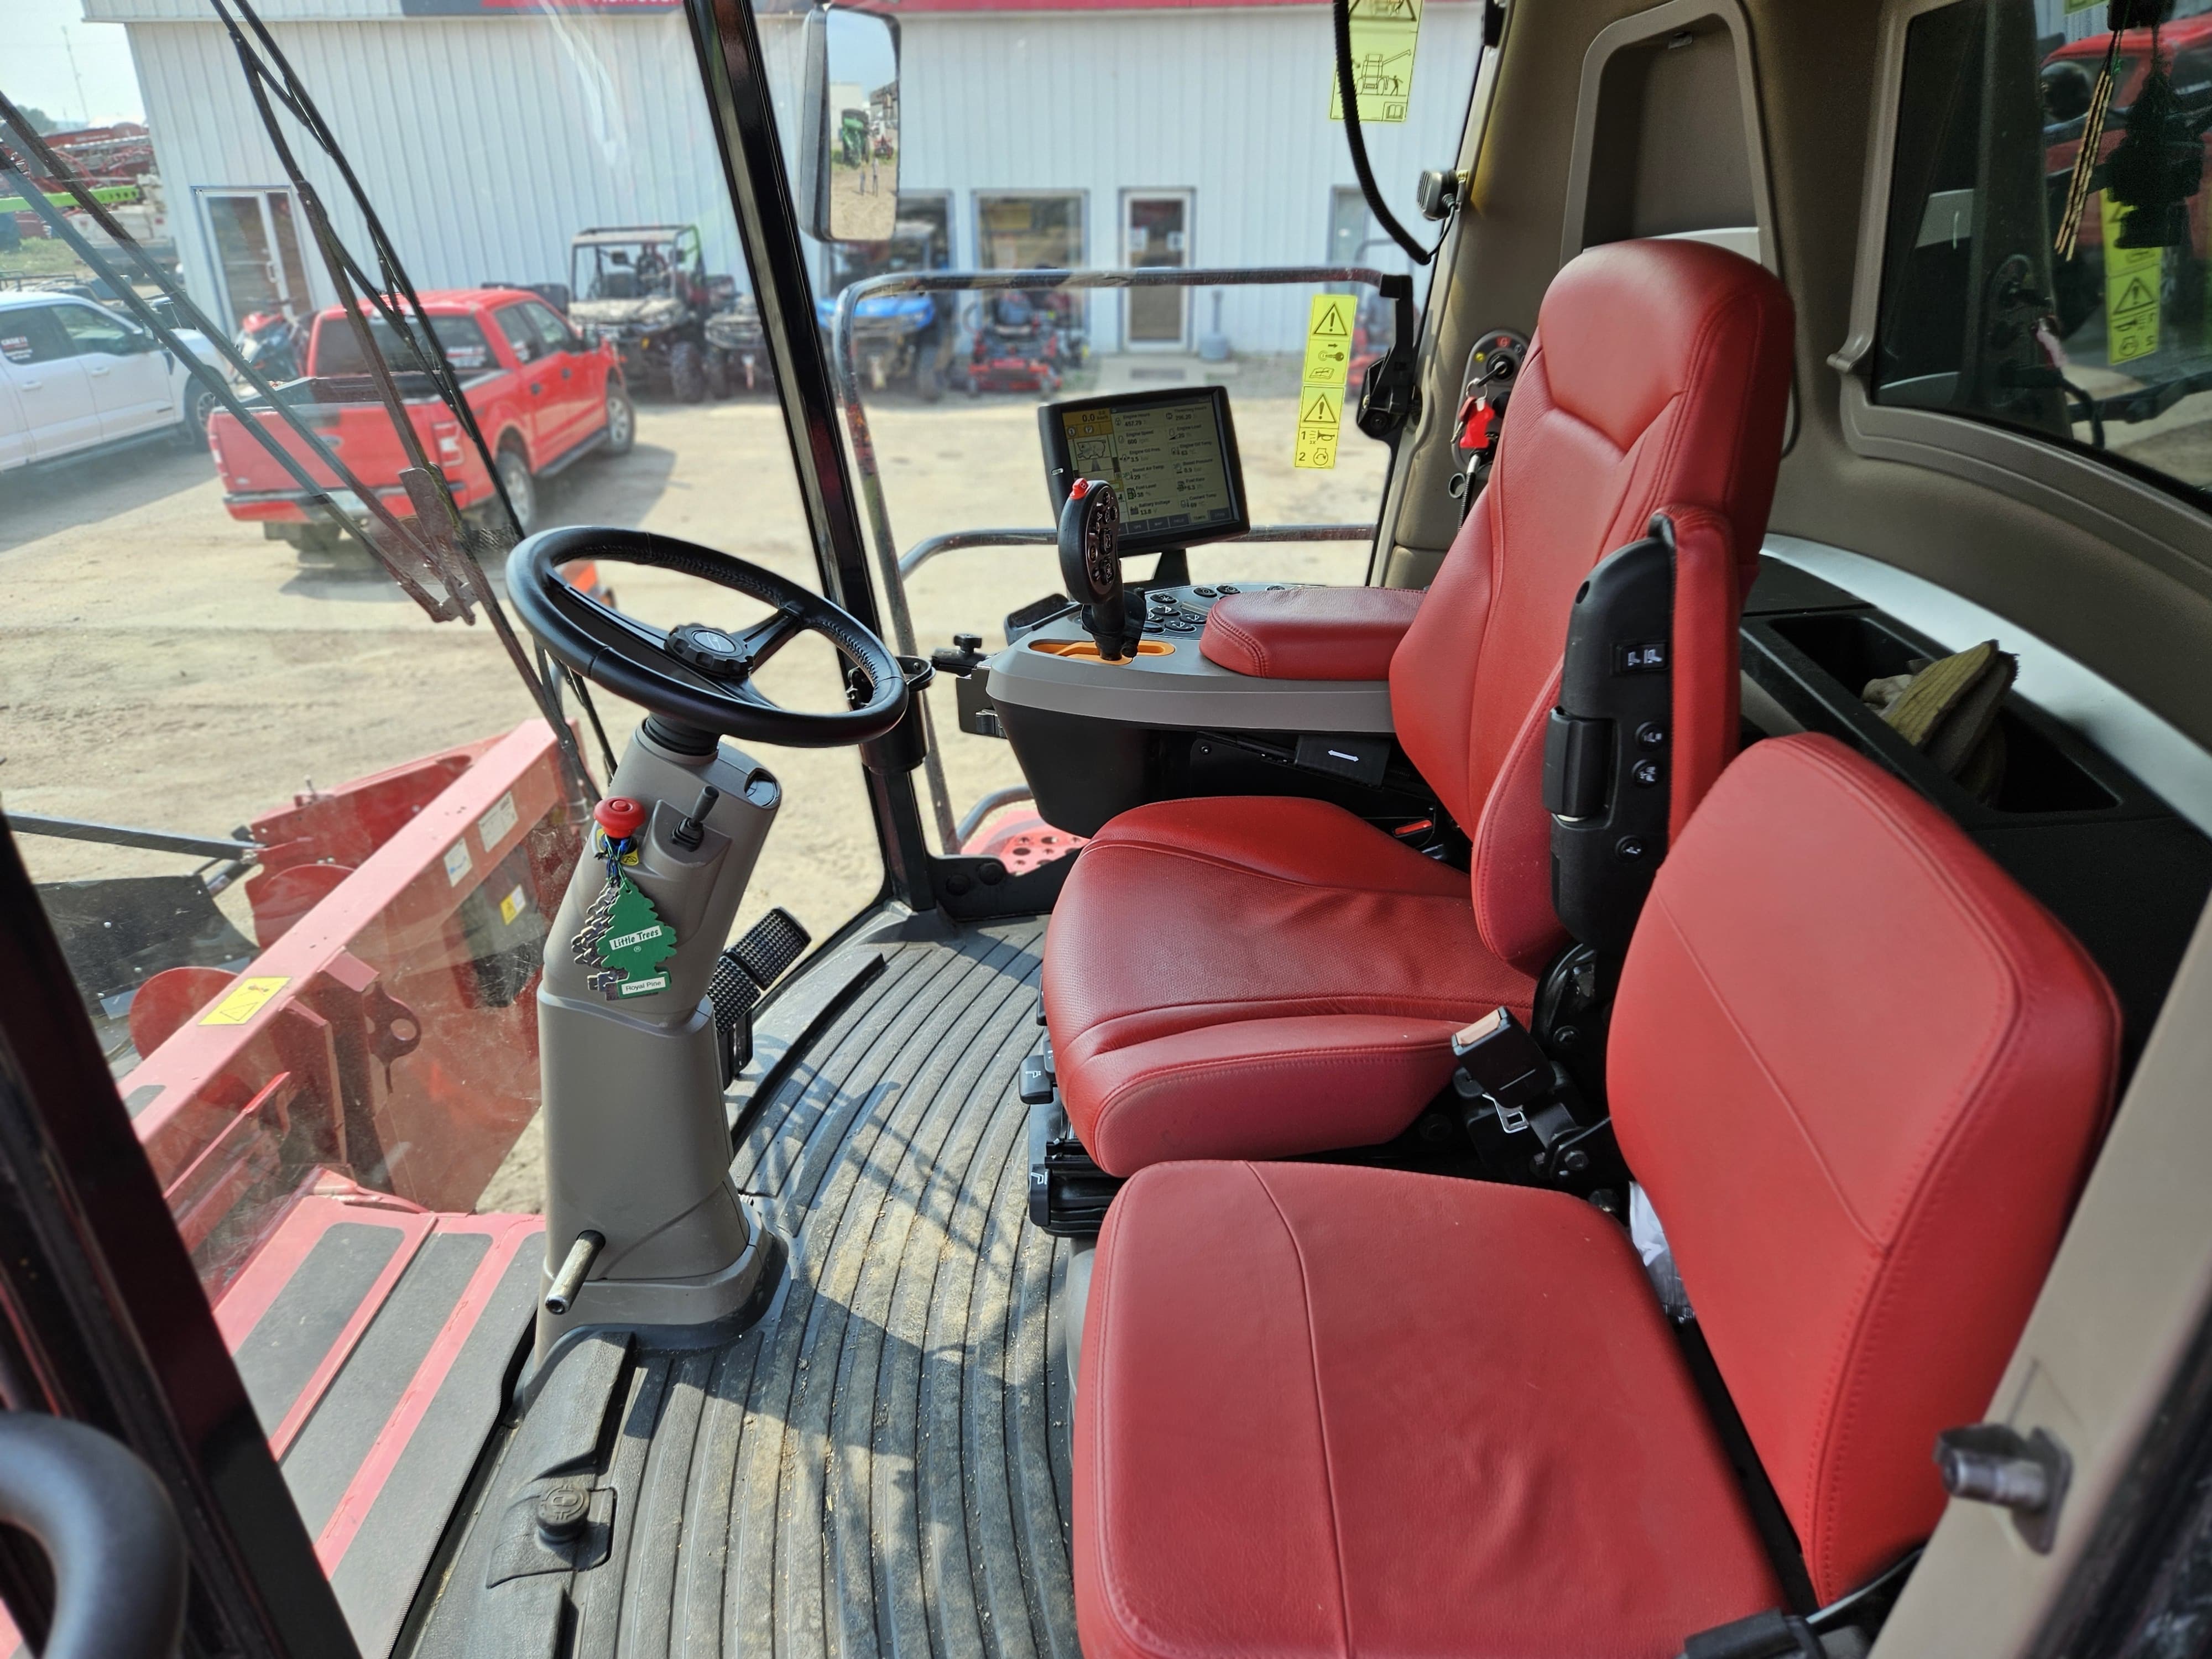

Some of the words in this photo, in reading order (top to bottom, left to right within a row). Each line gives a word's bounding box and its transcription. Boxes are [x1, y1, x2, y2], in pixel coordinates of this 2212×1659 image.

[1082, 414, 1095, 422] 0.0
[1301, 431, 1306, 440] 1
[1298, 452, 1306, 461] 2
[614, 936, 635, 948] Little
[637, 929, 659, 941] Trees
[625, 983, 645, 992] Royal
